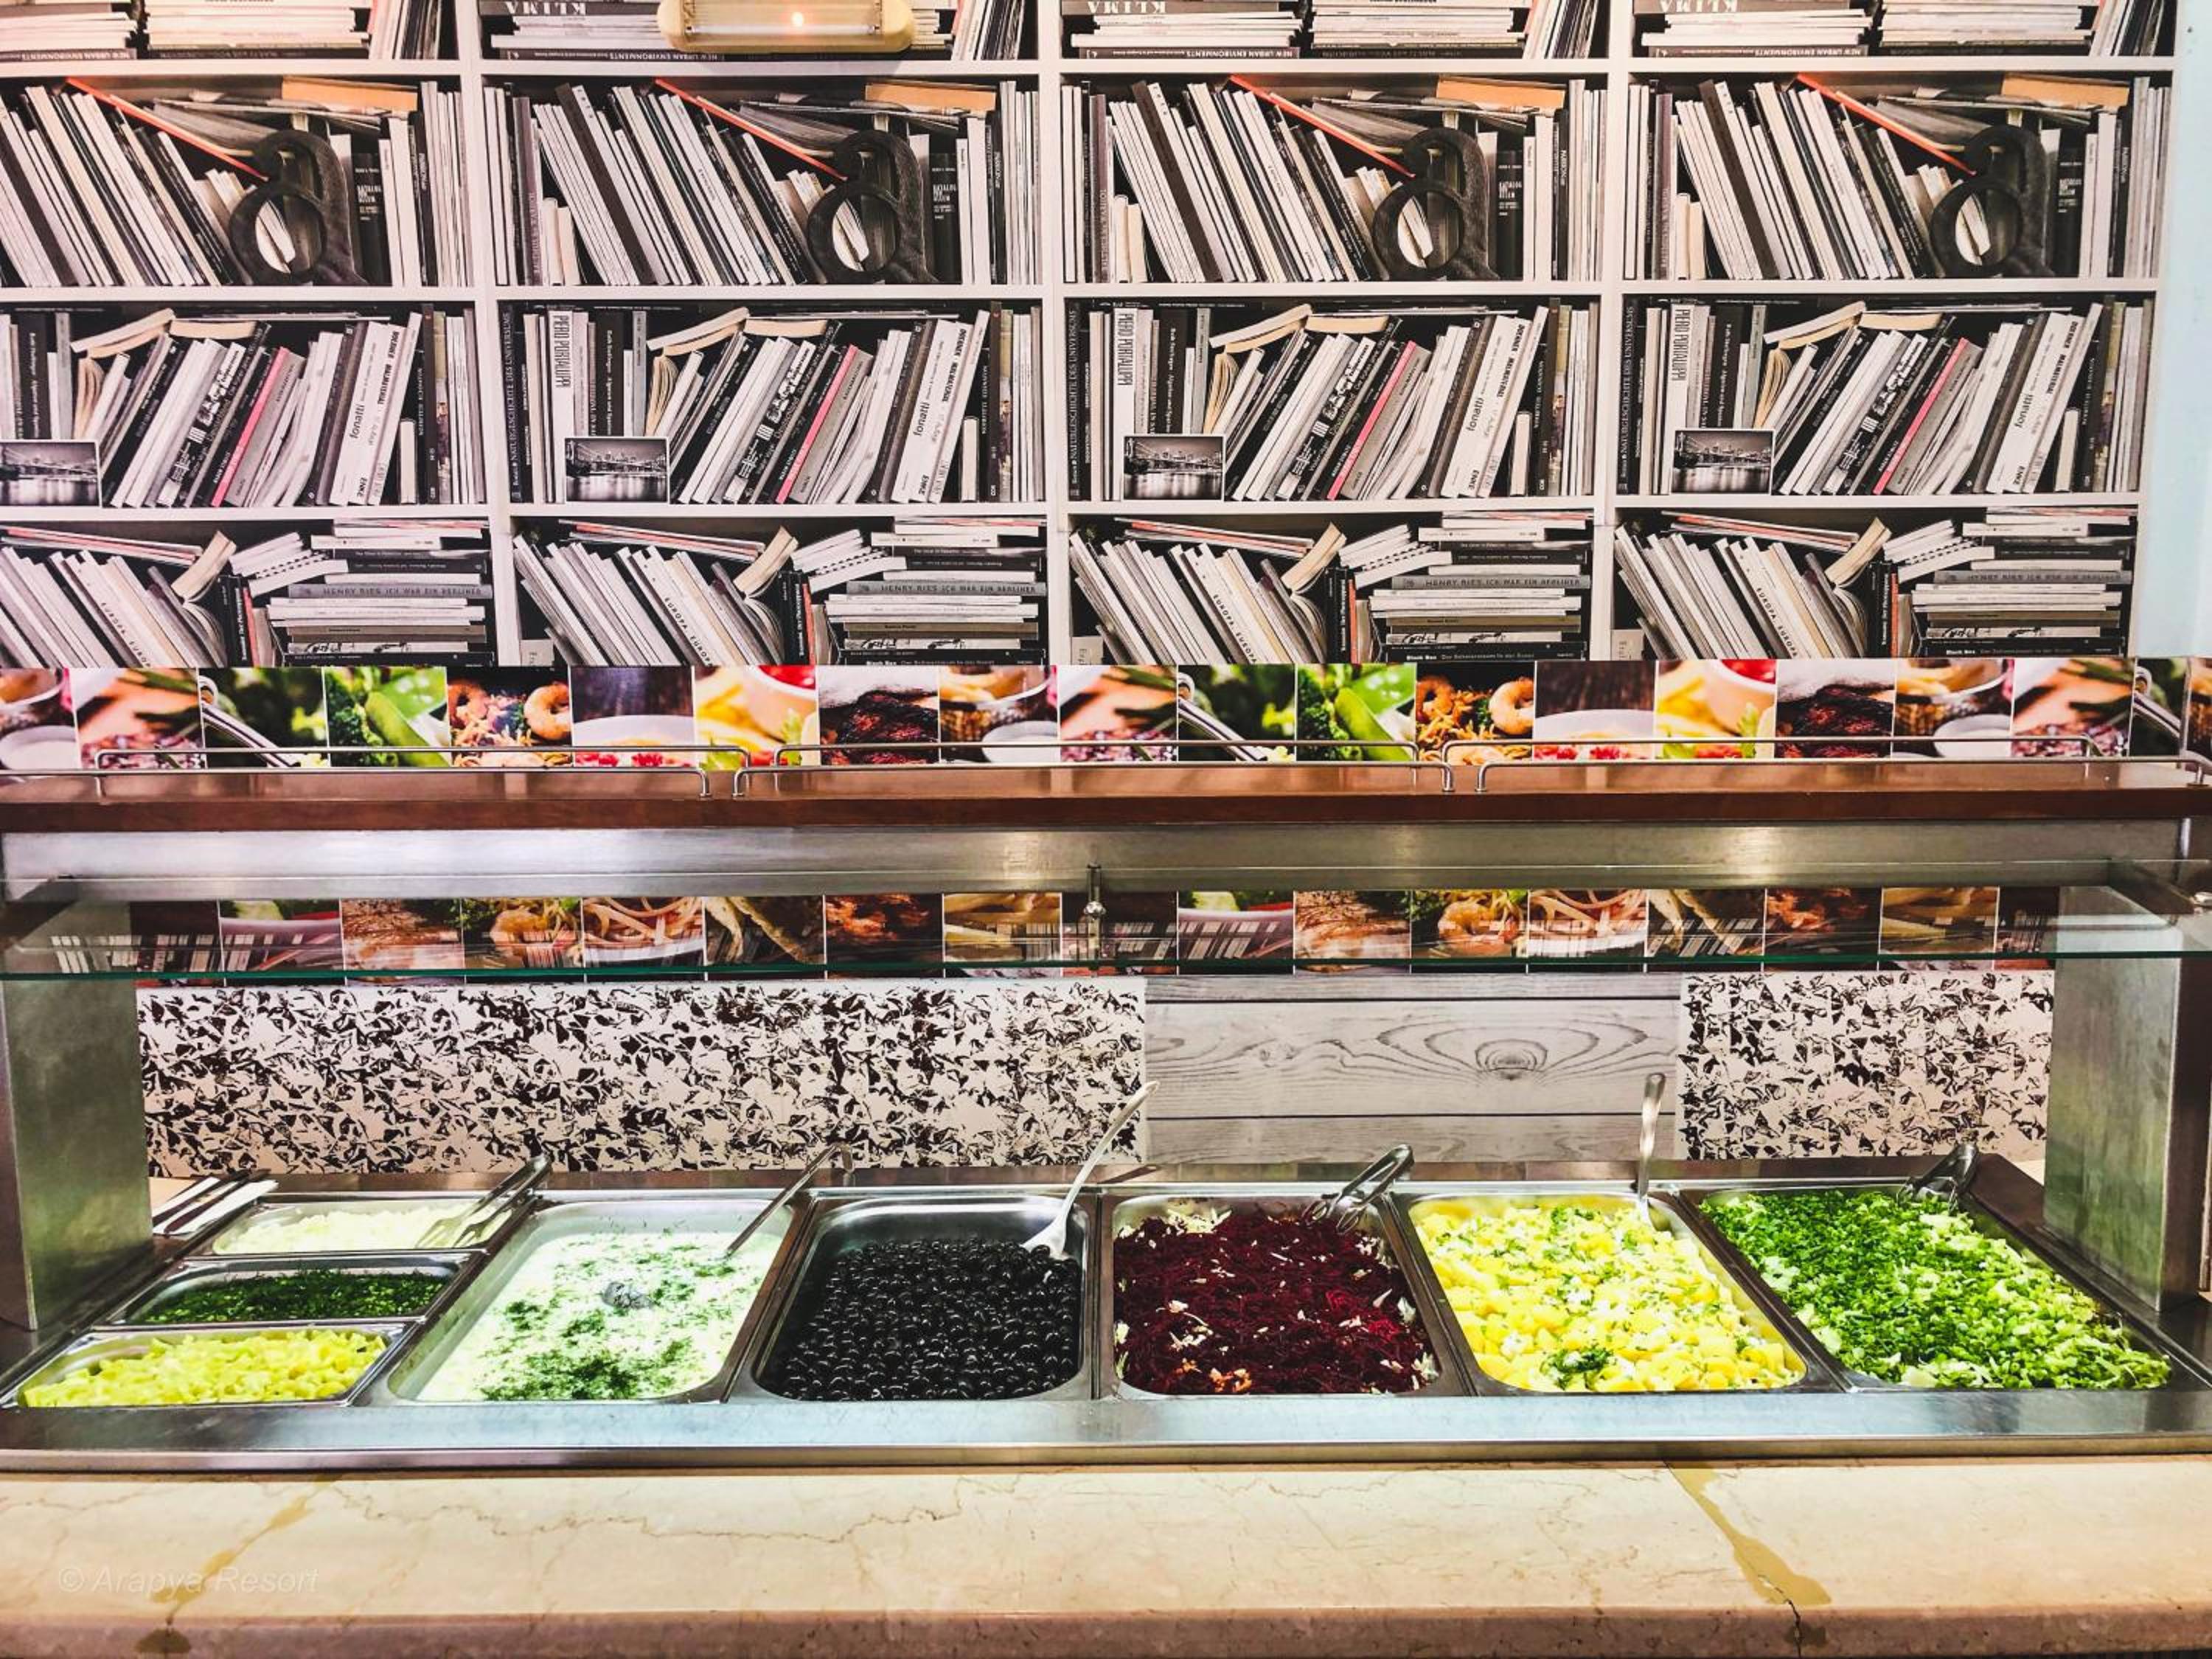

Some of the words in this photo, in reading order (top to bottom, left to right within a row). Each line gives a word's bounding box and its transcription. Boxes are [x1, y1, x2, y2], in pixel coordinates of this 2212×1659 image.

[506, 1, 587, 15] KLIMA
[1087, 1, 1166, 13] KLIMA
[1660, 0, 1738, 13] KLIMA
[553, 314, 571, 338] PIERO
[1116, 313, 1137, 336] PIERO
[1673, 309, 1690, 332] PIERO
[554, 340, 571, 388] PORTALUPPI
[1068, 364, 1077, 379] DES
[1116, 338, 1136, 386] PORTALUPPI
[1670, 334, 1688, 382] PORTALUPPI
[349, 403, 366, 439] fonatti
[913, 402, 930, 437] fonatti
[1069, 381, 1077, 459] NATURGESCHICHTE
[1467, 397, 1484, 432] fonatti
[2015, 393, 2034, 430] fonatti
[357, 476, 367, 498] ENKE
[1234, 631, 1259, 664] EUROPA
[1775, 625, 1799, 658] EUROPA
